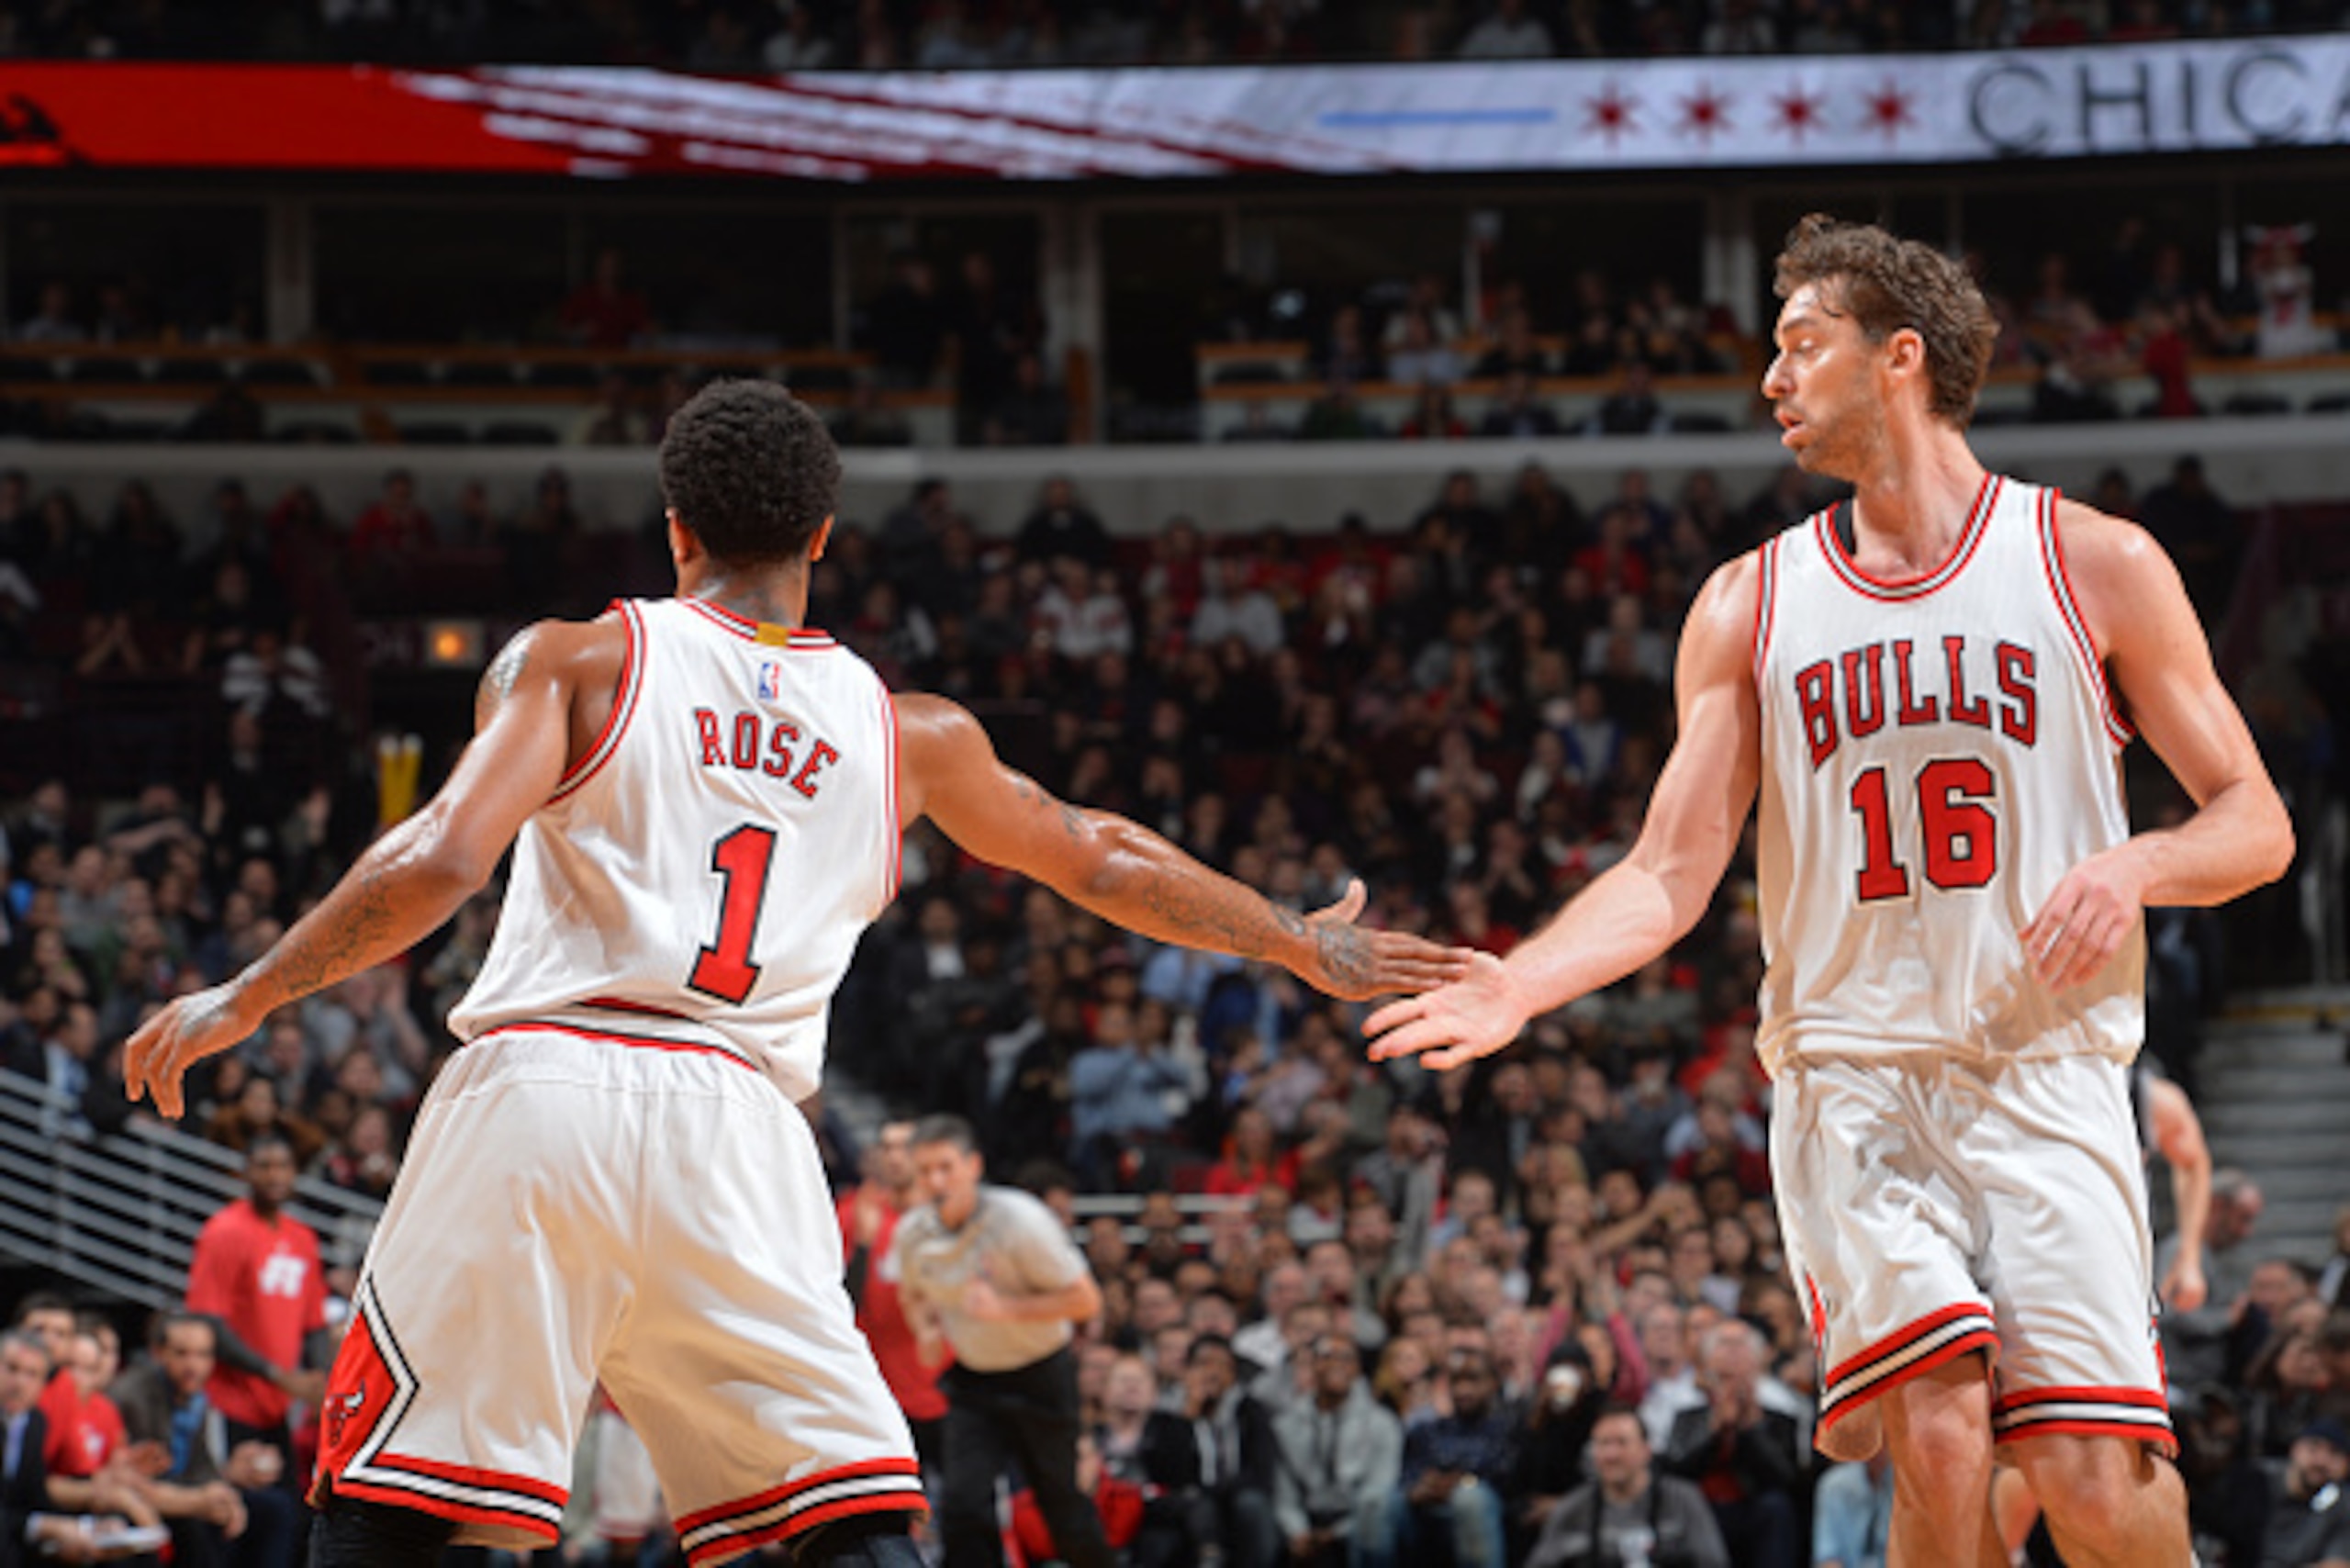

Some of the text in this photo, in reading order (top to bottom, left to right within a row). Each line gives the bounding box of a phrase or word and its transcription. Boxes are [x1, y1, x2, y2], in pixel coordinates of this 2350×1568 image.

[1967, 43, 2350, 151] CHIC
[693, 707, 841, 801] ROSE
[1795, 635, 2036, 773] BULLS
[1850, 756, 1997, 903] 16
[684, 822, 778, 1008] 1
